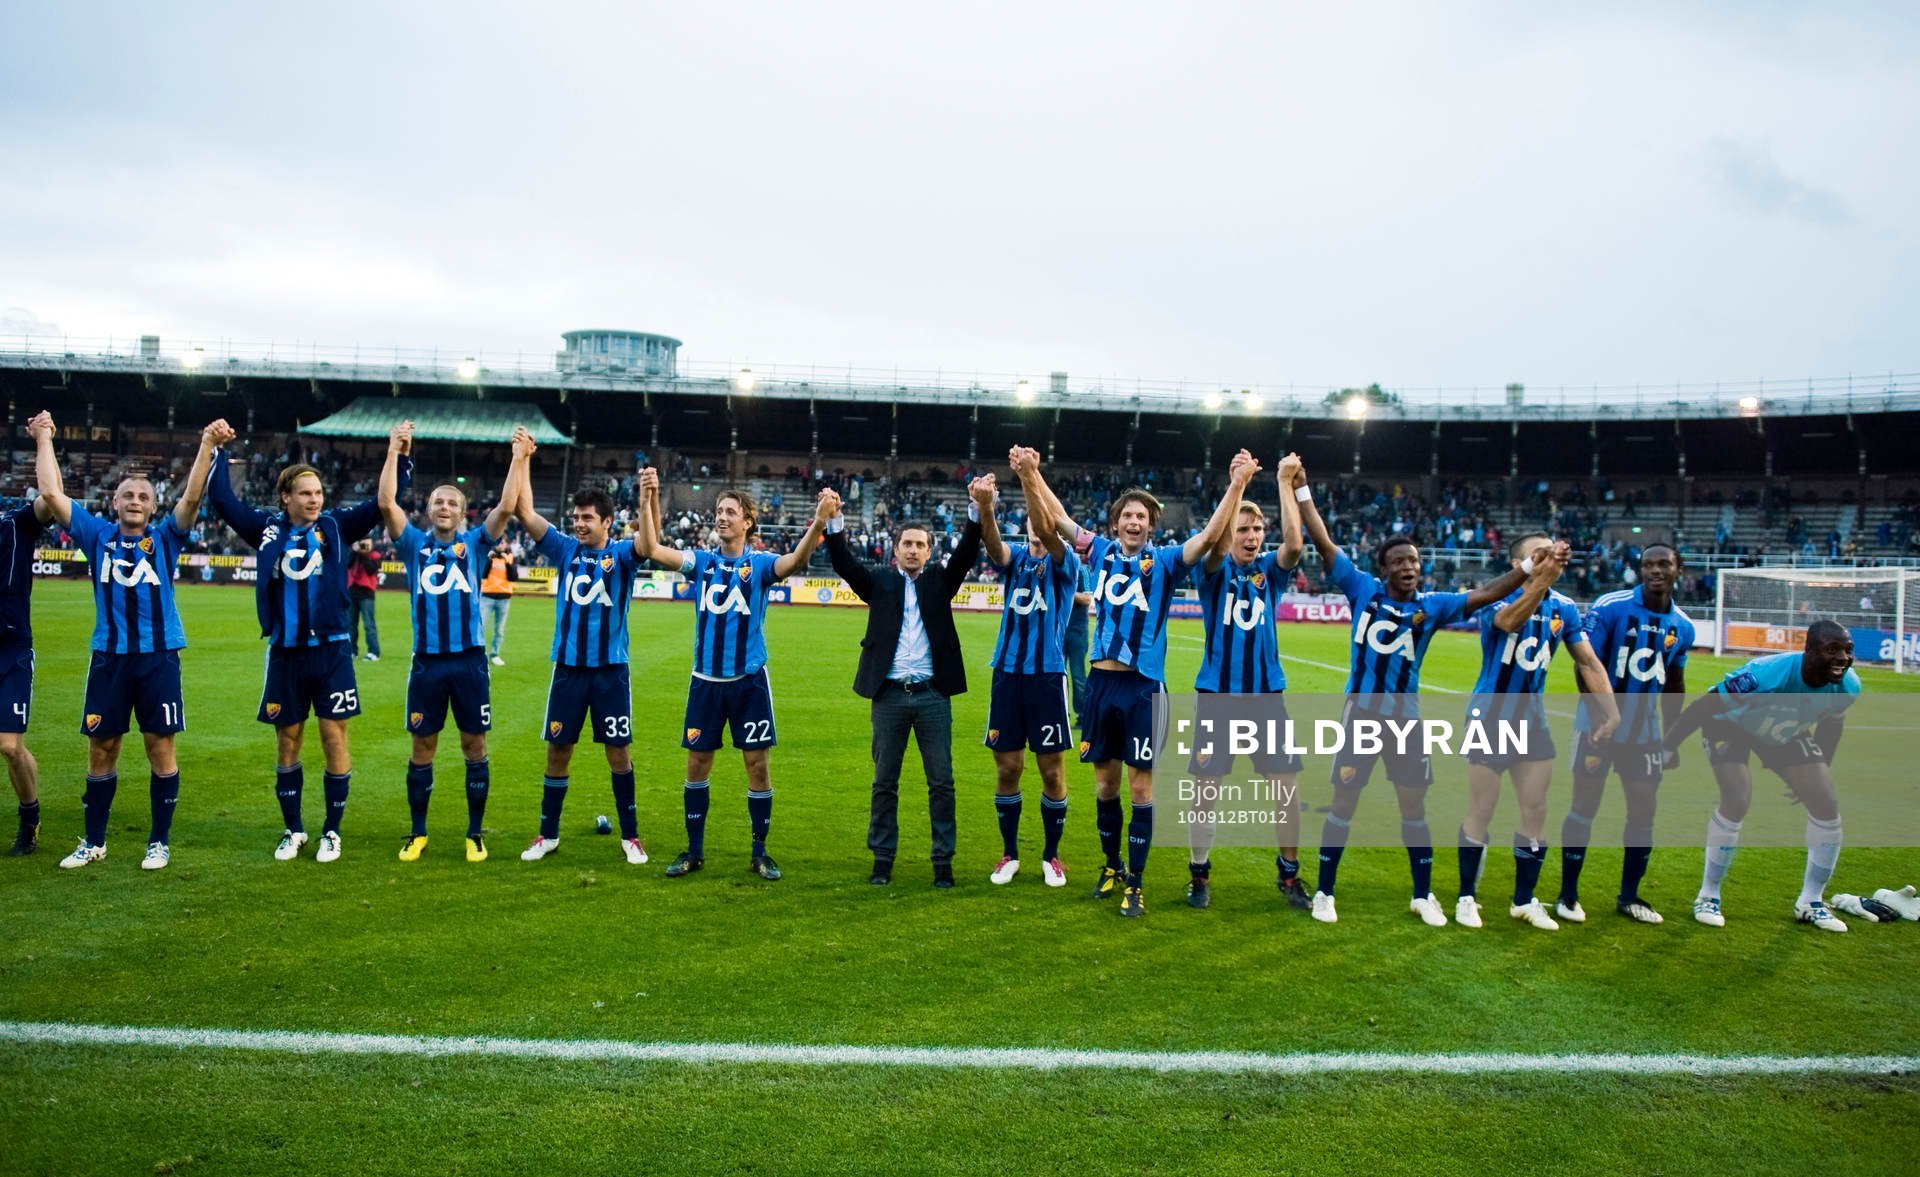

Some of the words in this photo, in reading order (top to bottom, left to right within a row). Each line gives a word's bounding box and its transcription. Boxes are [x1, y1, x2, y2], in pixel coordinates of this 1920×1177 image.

[32, 560, 62, 574] das
[100, 552, 161, 587] ICA
[232, 568, 257, 581] Jon
[417, 563, 472, 594] ICA
[565, 572, 614, 607] ICA
[699, 580, 751, 615] ICA
[835, 591, 859, 601] POS
[1009, 585, 1048, 615] CA
[1093, 569, 1150, 612] ICA
[1293, 604, 1352, 620] TELIA
[1354, 611, 1415, 661] ICA
[1502, 632, 1551, 671] ICA
[1615, 646, 1666, 685] ICA
[330, 689, 357, 713] 25
[13, 703, 26, 725] 4
[162, 702, 178, 725] 11
[480, 704, 490, 725] 5
[604, 716, 630, 738] 33
[743, 720, 772, 743] 22
[1041, 724, 1062, 746] 21
[1133, 737, 1153, 760] 16
[1797, 737, 1823, 757] 15
[1644, 752, 1662, 775] 14
